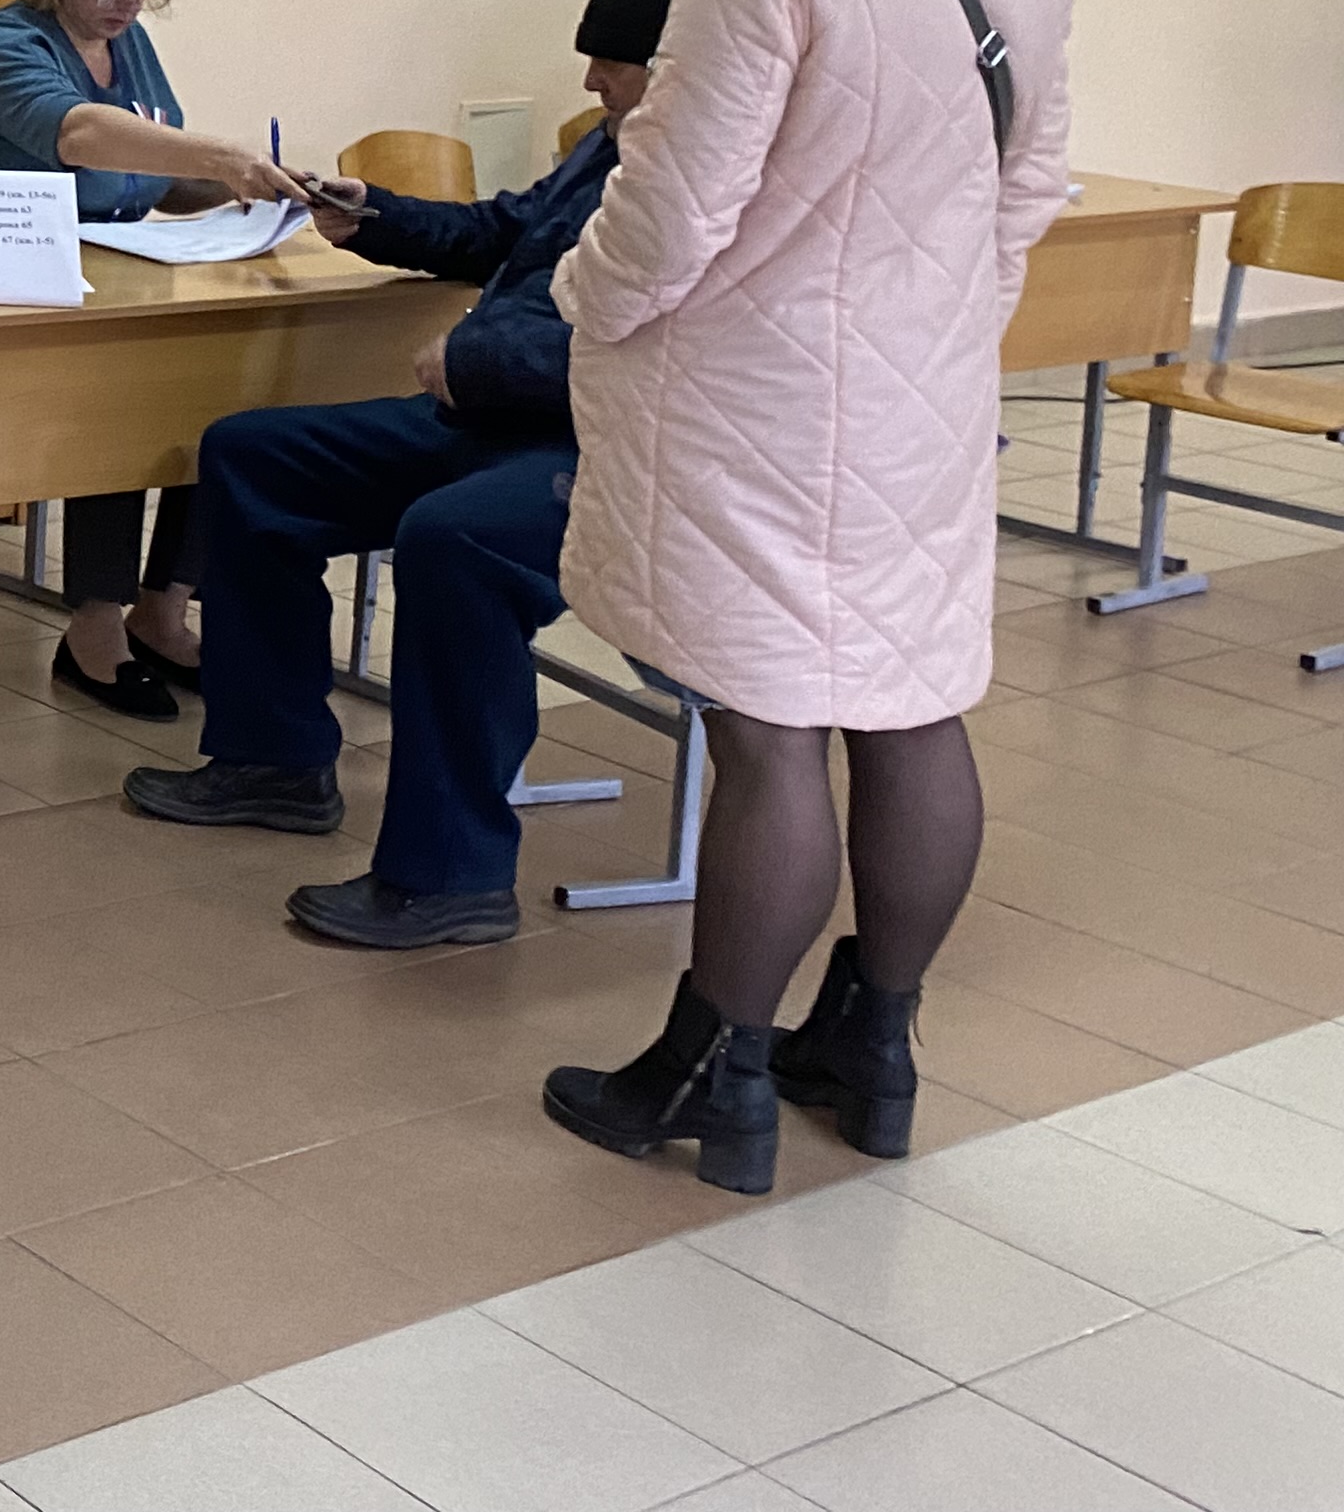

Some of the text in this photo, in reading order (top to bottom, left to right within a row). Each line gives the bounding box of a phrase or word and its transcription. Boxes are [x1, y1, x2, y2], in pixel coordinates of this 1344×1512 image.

[20, 205, 32, 213] 63
[21, 221, 32, 229] 65
[2, 235, 12, 243] 67
